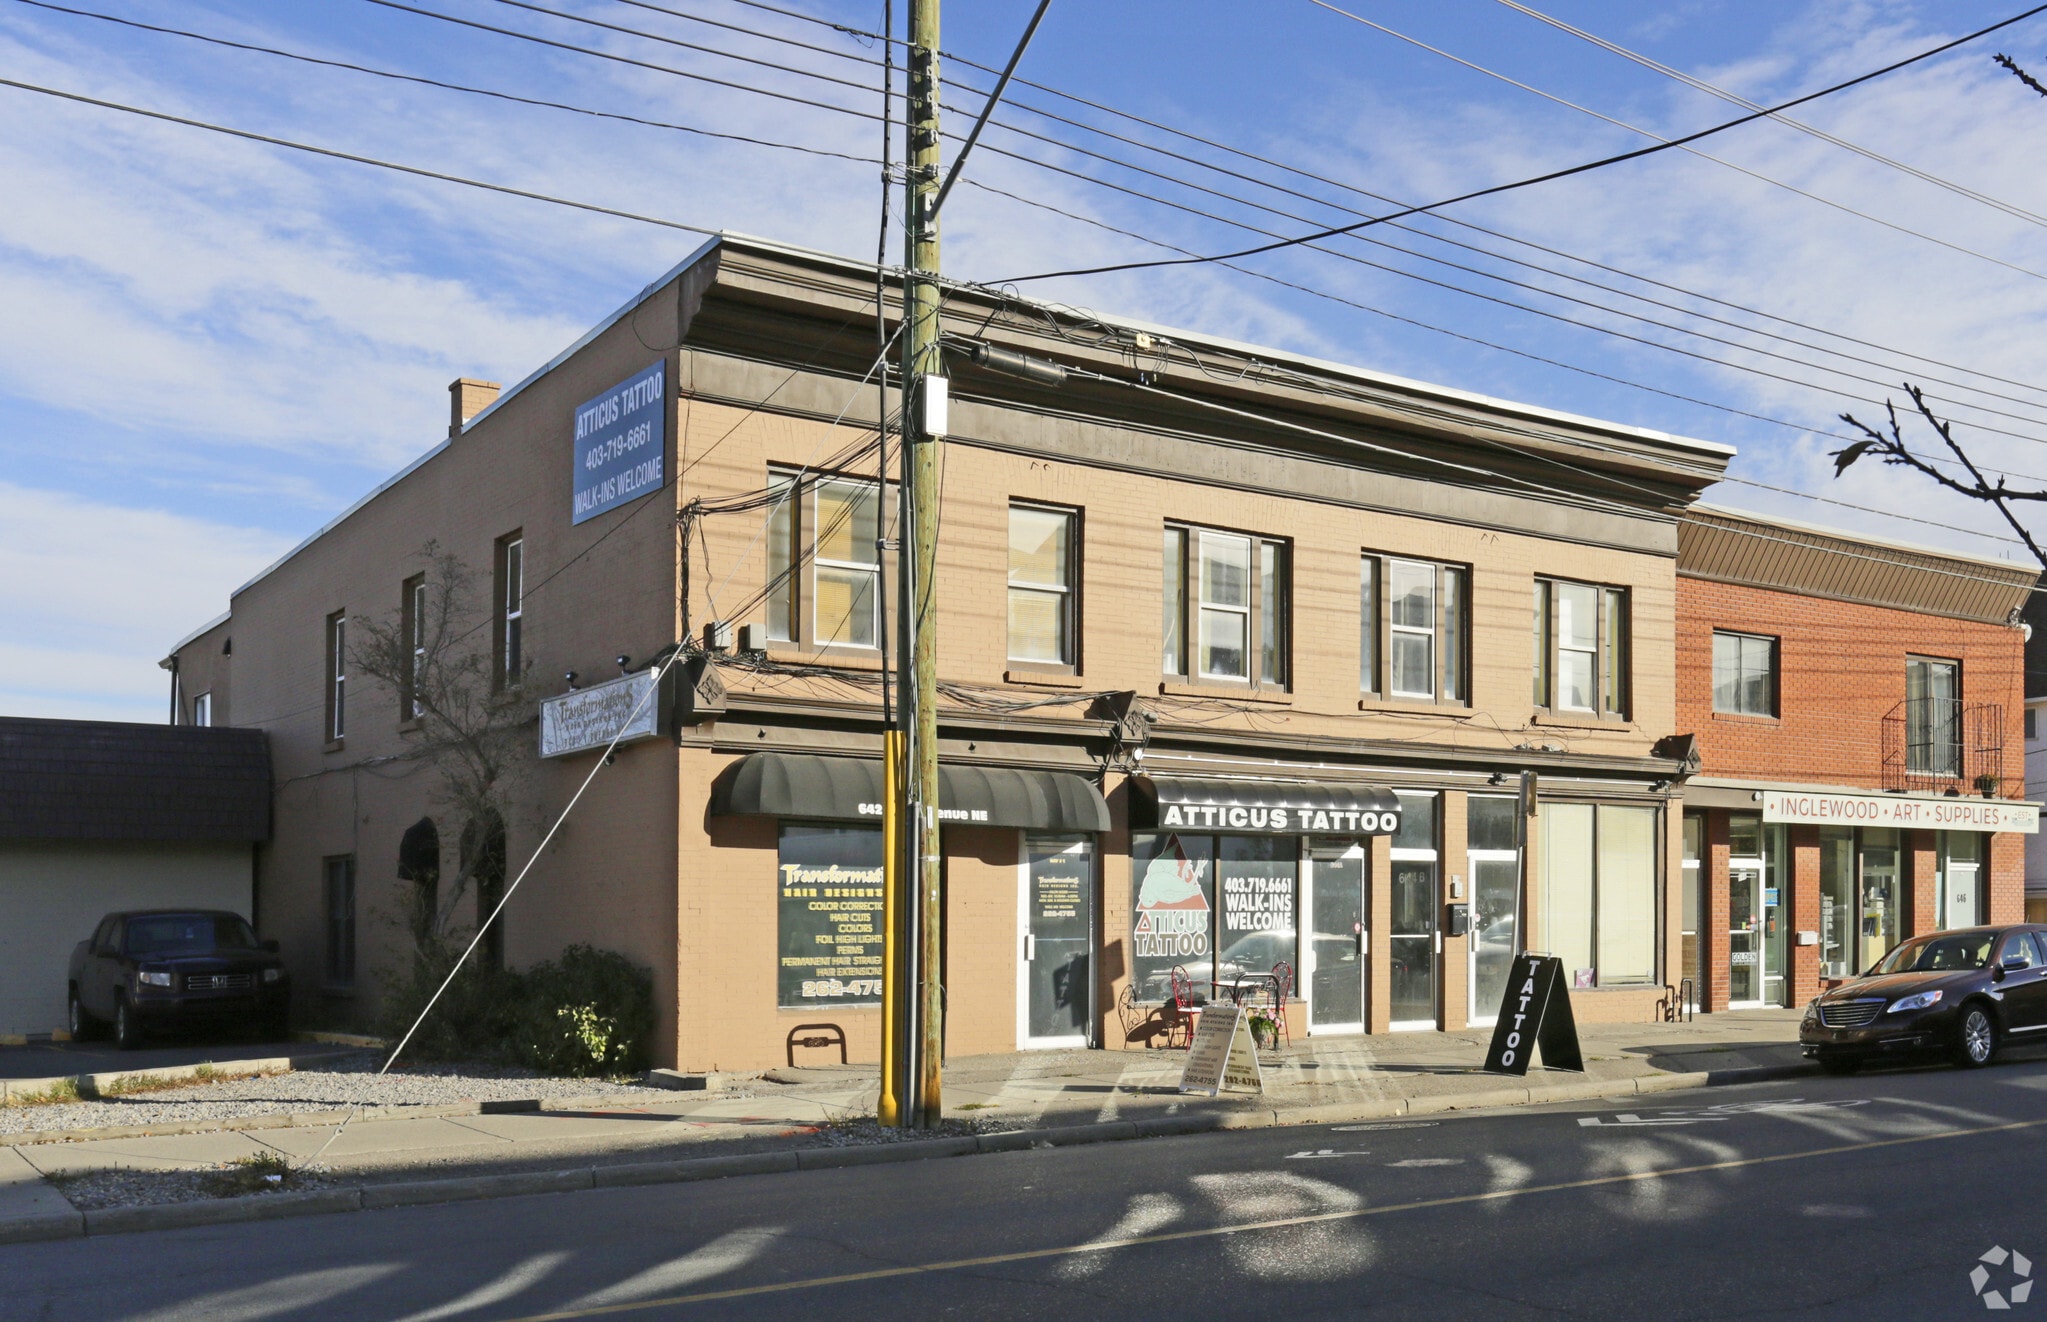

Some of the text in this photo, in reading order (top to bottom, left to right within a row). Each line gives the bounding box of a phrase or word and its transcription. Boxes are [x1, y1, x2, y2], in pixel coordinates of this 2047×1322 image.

[577, 372, 662, 440] ATTICUS TATTOO
[586, 421, 651, 470] 403-719-6661
[575, 456, 662, 515] WALK-INS WELCOME
[858, 803, 988, 821] 642 enue NE
[1164, 805, 1397, 831] ATTICUS TATTOO
[1781, 797, 1999, 825] INGLEWOOD ART SUPPLIES
[780, 864, 883, 886] Transformati
[783, 888, 817, 897] HAIR
[1224, 877, 1292, 893] 403.719.6661
[808, 901, 883, 910] COLOR CORRECTIO
[1225, 893, 1292, 911] WALK-INS
[830, 913, 871, 922] HAIR CUTS
[1134, 910, 1208, 933] ATTICUS
[1225, 912, 1292, 930] WELCOME
[838, 924, 873, 933] COLORS
[815, 935, 834, 944] FOIL
[835, 935, 856, 943] HIGH
[1134, 933, 1208, 957] TATTOO
[836, 946, 864, 954] PERMS
[782, 957, 830, 966] PERMANENT
[832, 957, 851, 965] HAIR
[816, 968, 836, 976] HAIR
[802, 980, 882, 997] 262-475
[1502, 960, 1541, 1066] TATTOO
[1185, 1075, 1217, 1085] 262-4755
